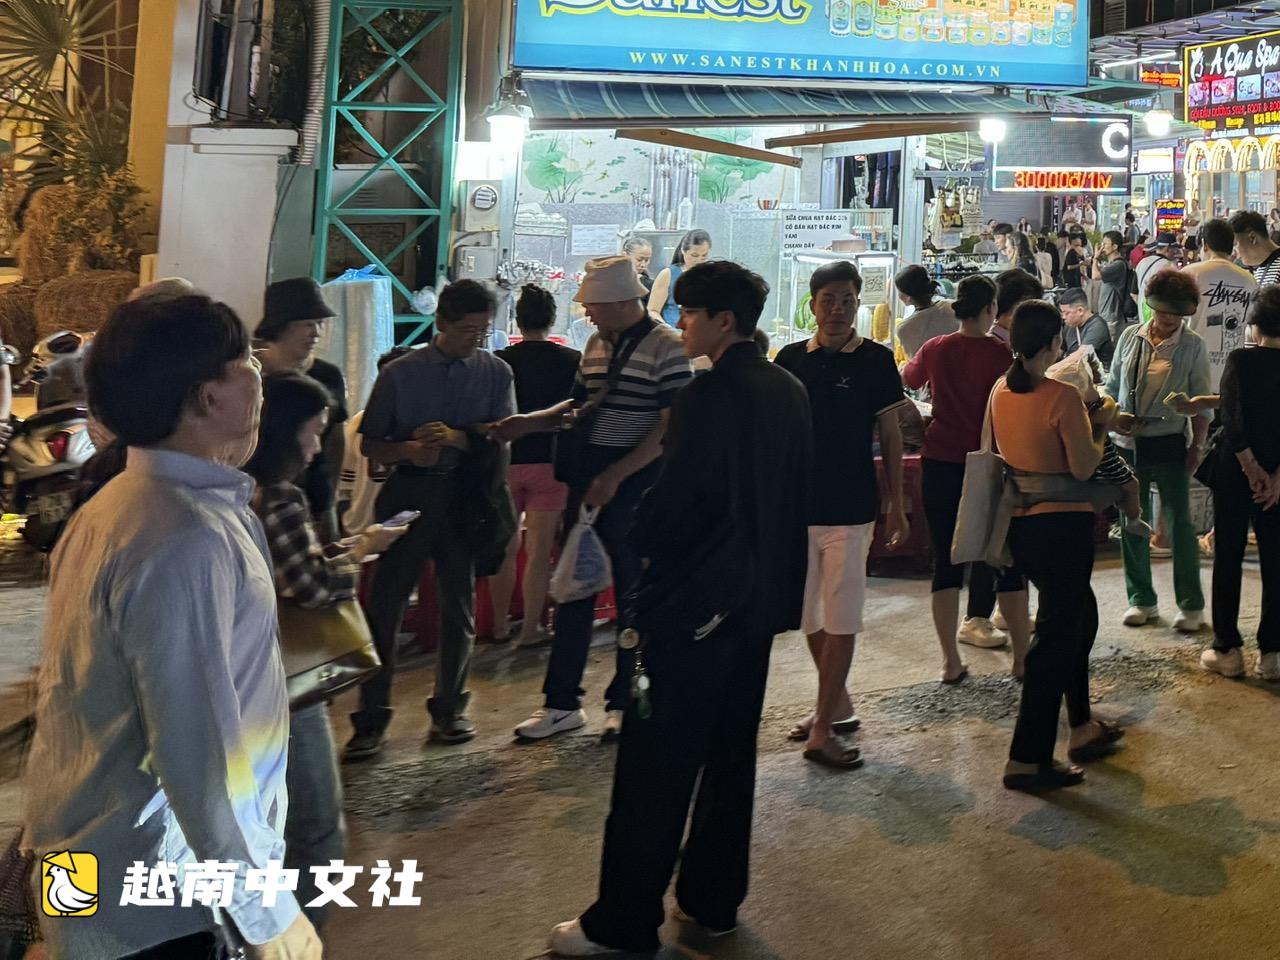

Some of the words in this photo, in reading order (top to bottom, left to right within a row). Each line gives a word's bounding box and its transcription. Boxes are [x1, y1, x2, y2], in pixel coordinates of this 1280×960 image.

[628, 49, 1001, 78] WWW.SANESTKHANHHOA.COM.VN
[1255, 38, 1280, 77] Spa
[1102, 123, 1129, 159] C
